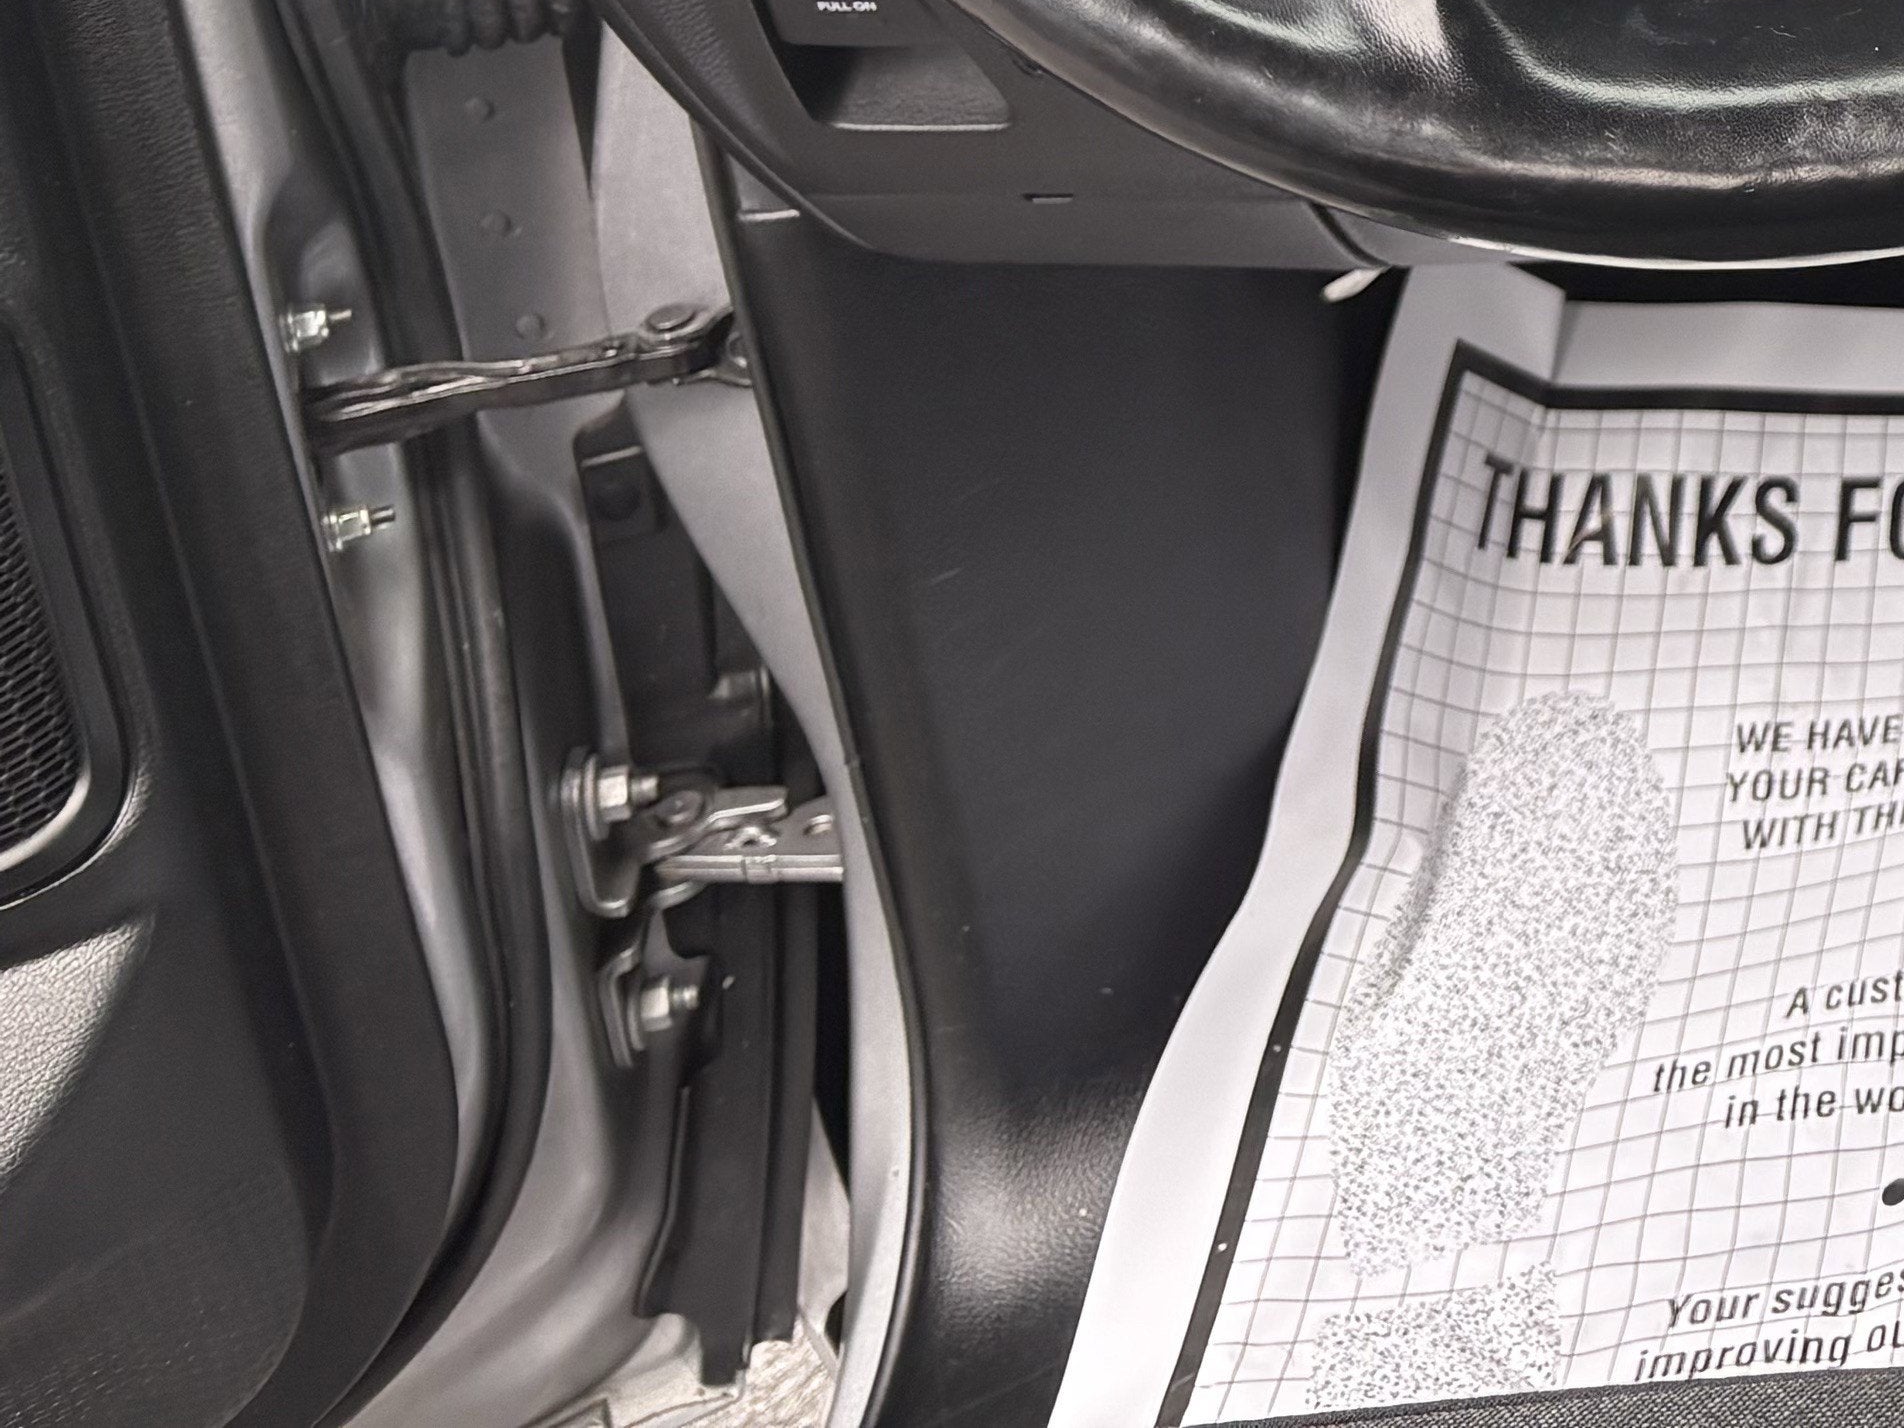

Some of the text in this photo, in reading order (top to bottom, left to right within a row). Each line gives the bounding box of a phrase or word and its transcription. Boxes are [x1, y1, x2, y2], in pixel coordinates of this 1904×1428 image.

[1477, 453, 1799, 567] THANKS
[1736, 721, 1795, 753] WE
[1807, 713, 1903, 750] HAVE
[1726, 768, 1829, 802] YOUR
[1742, 811, 1837, 849] WITH
[1785, 987, 1809, 1019] A
[1653, 1059, 1709, 1093] the
[1727, 1034, 1822, 1079] most
[1725, 1095, 1758, 1129] in
[1776, 1085, 1836, 1122] the
[1668, 1293, 1760, 1328] Your
[1635, 1329, 1852, 1380] improving
